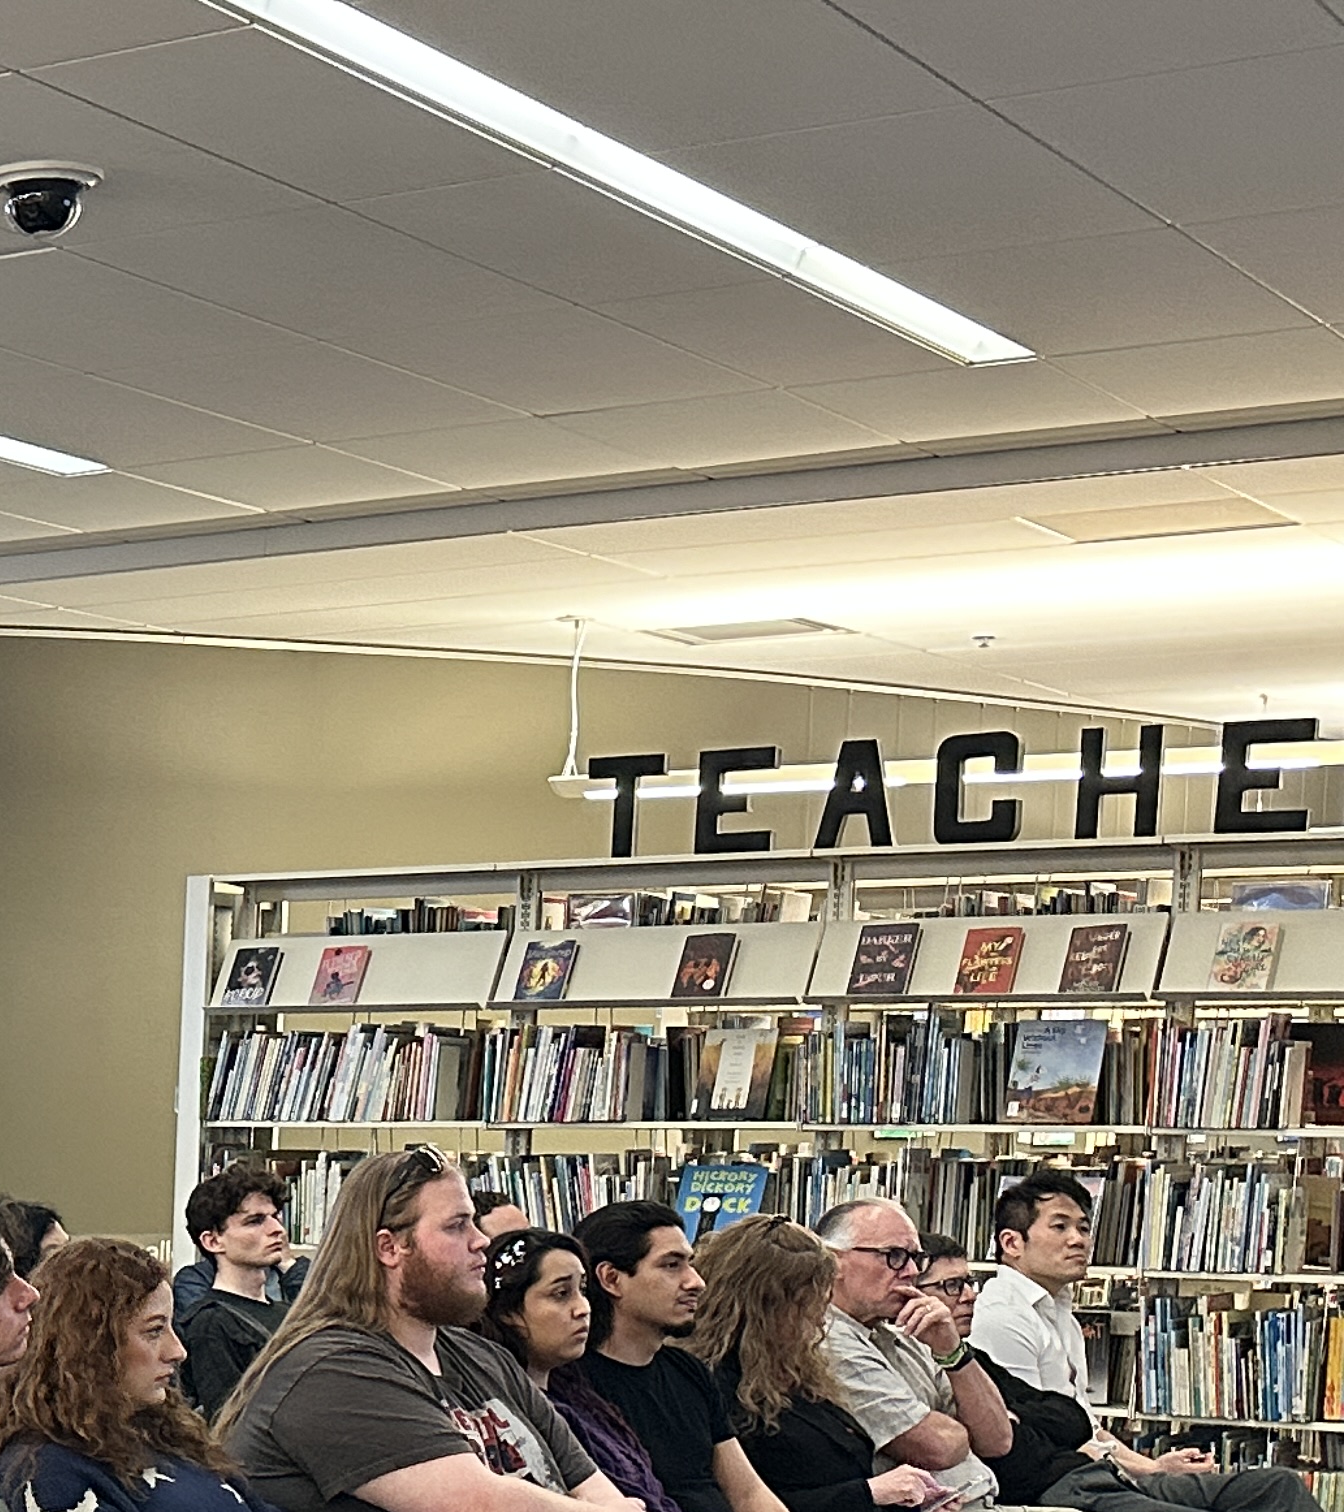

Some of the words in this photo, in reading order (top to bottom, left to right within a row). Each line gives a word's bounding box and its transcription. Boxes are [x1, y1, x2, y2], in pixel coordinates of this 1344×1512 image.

[589, 717, 1317, 857] TEACHE
[693, 1170, 759, 1182] HICKORY
[690, 1181, 757, 1195] DICKORY
[684, 1196, 752, 1213] DOCK
